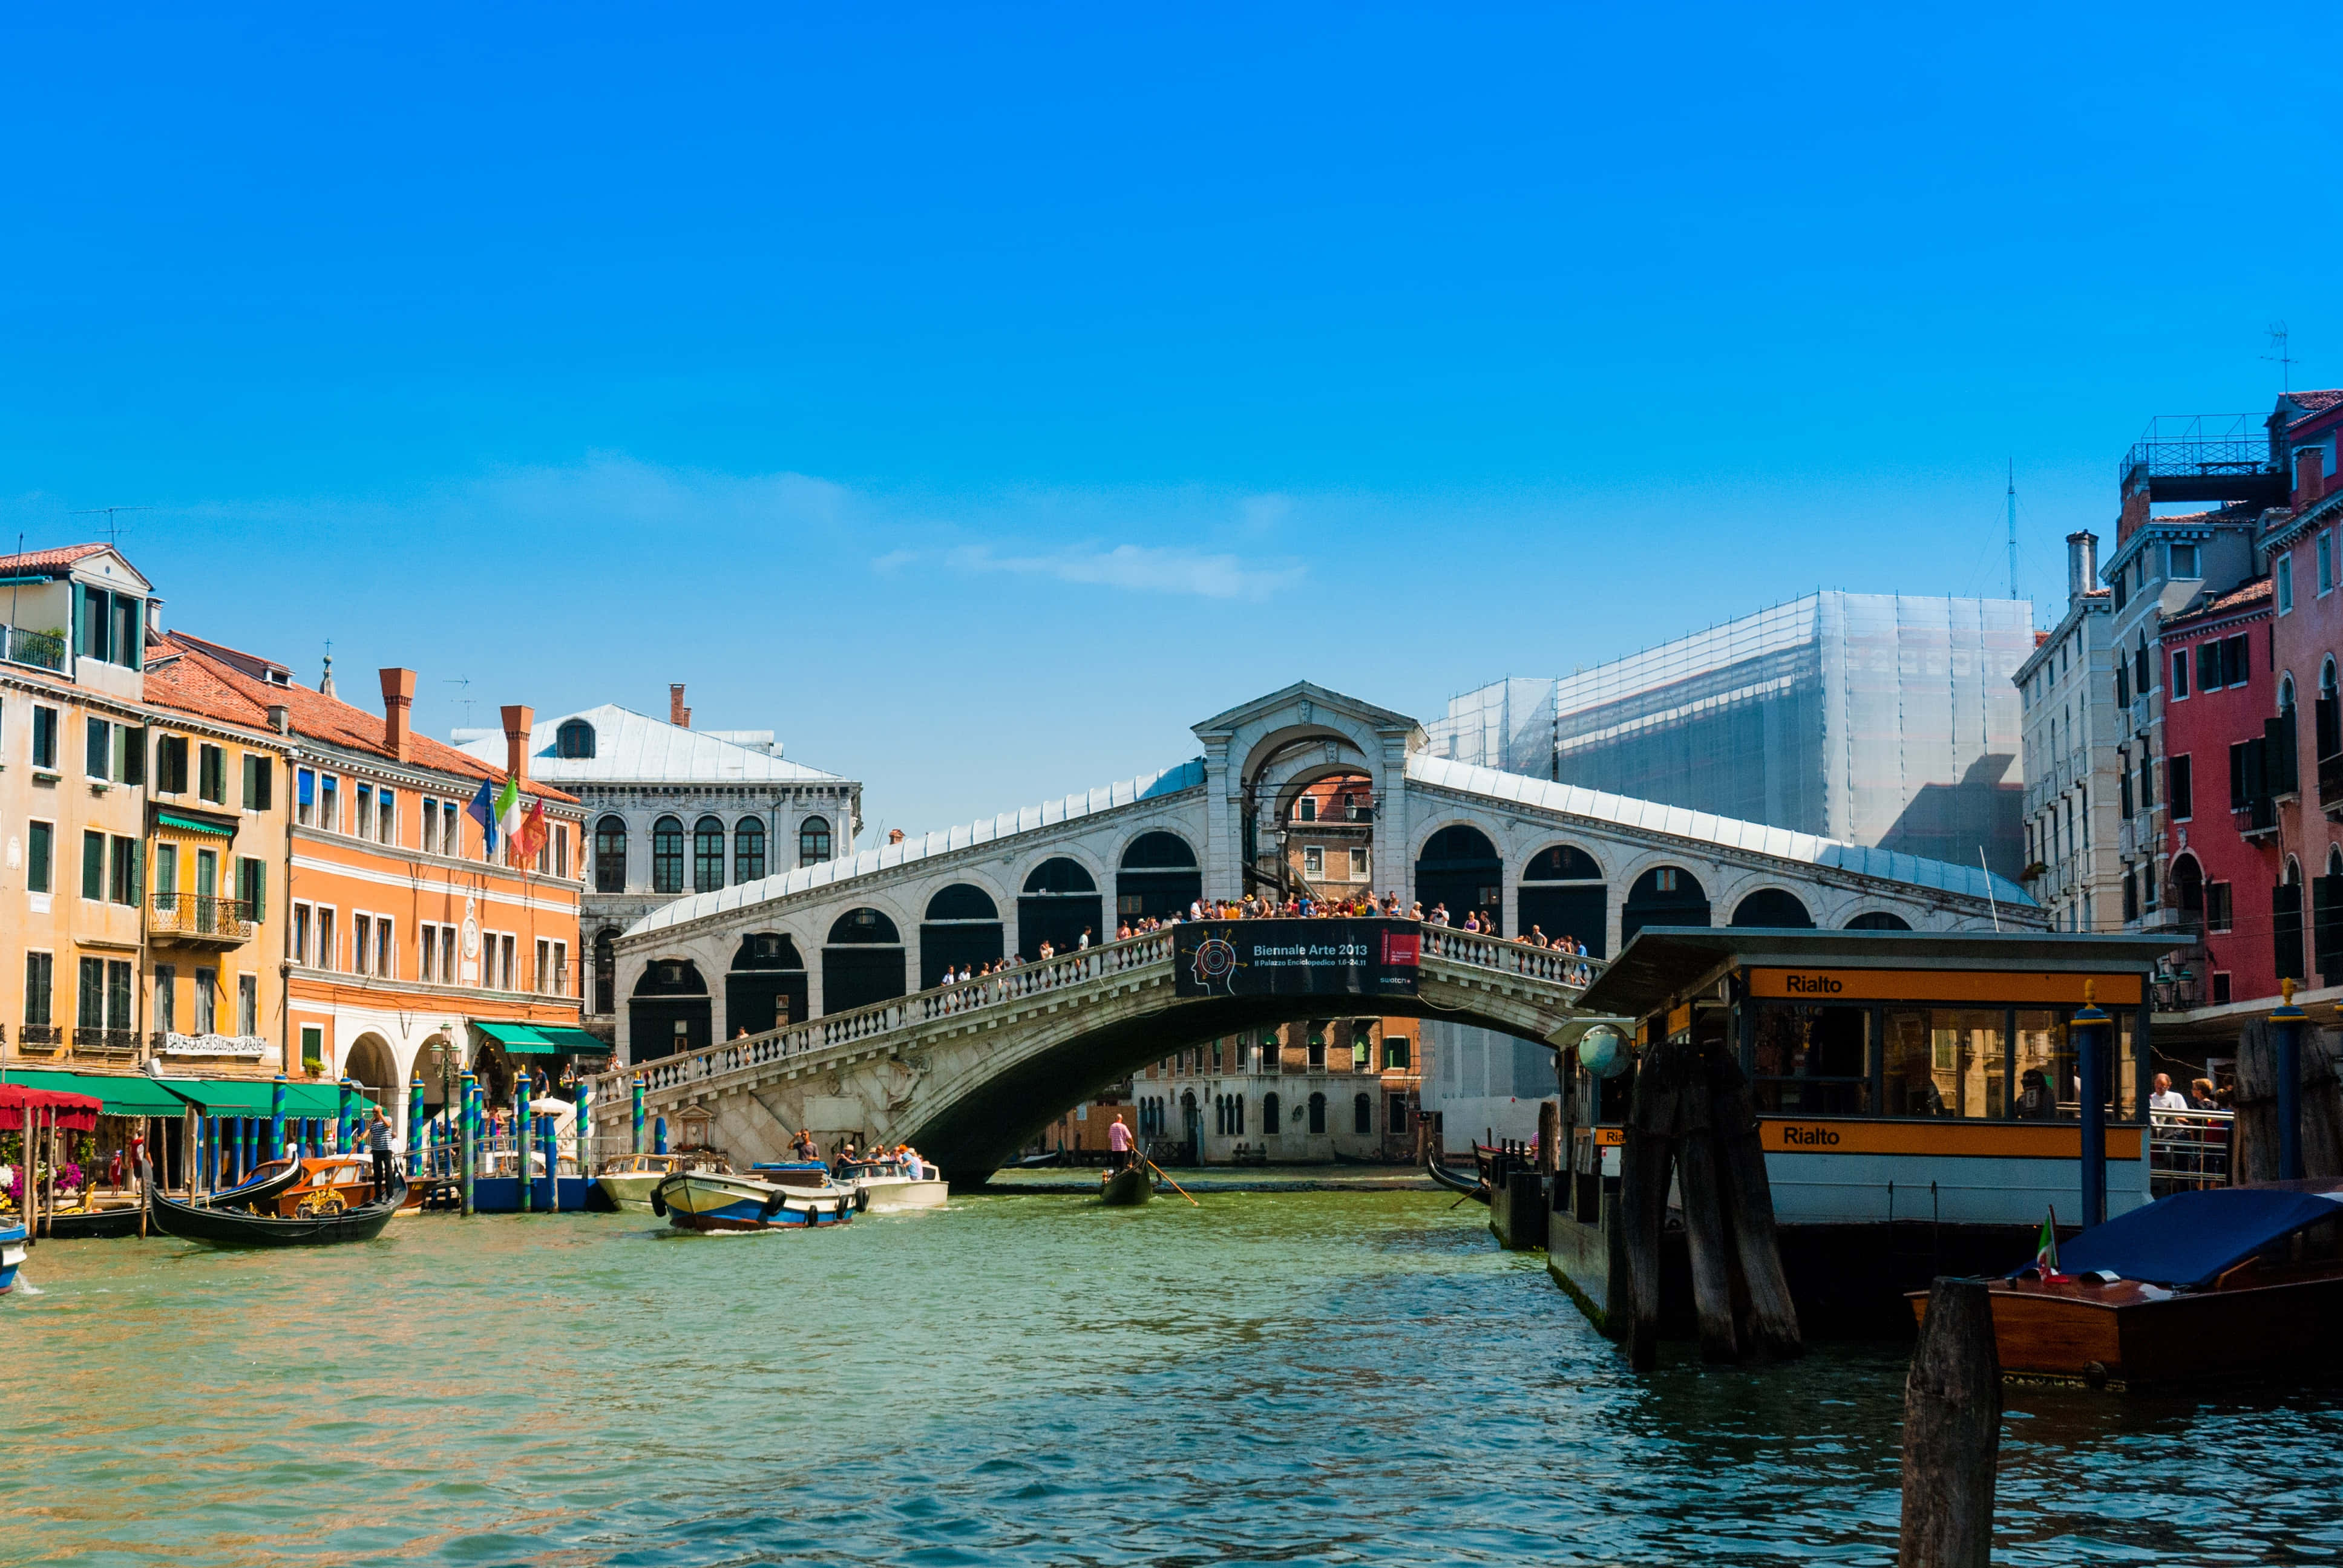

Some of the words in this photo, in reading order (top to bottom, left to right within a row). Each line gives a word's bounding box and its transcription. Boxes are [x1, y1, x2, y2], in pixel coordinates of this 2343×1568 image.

[1254, 944, 1306, 956] Biennale
[1309, 944, 1336, 955] Arte
[1339, 944, 1368, 956] 2013
[1787, 975, 1843, 993] Rialto
[1607, 1131, 1625, 1142] Ria
[1784, 1127, 1840, 1145] Rialto
